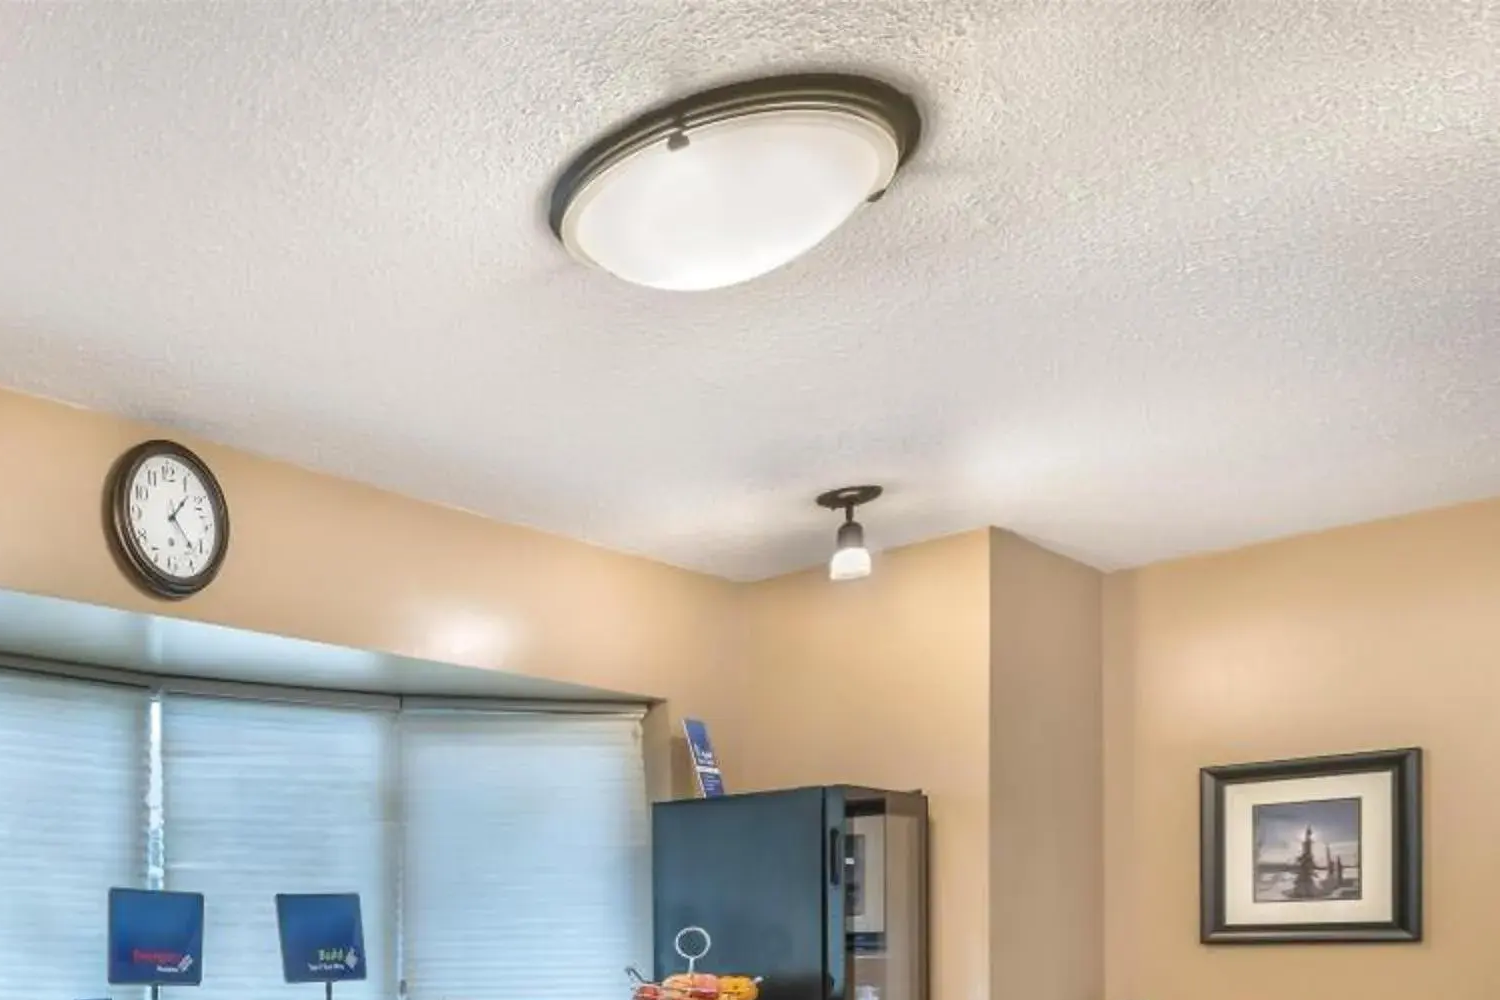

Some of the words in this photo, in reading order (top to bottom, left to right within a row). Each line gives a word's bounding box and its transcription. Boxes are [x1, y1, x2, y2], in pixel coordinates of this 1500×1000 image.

[147, 469, 157, 487] 11
[161, 465, 175, 483] 12
[135, 484, 149, 501] 10
